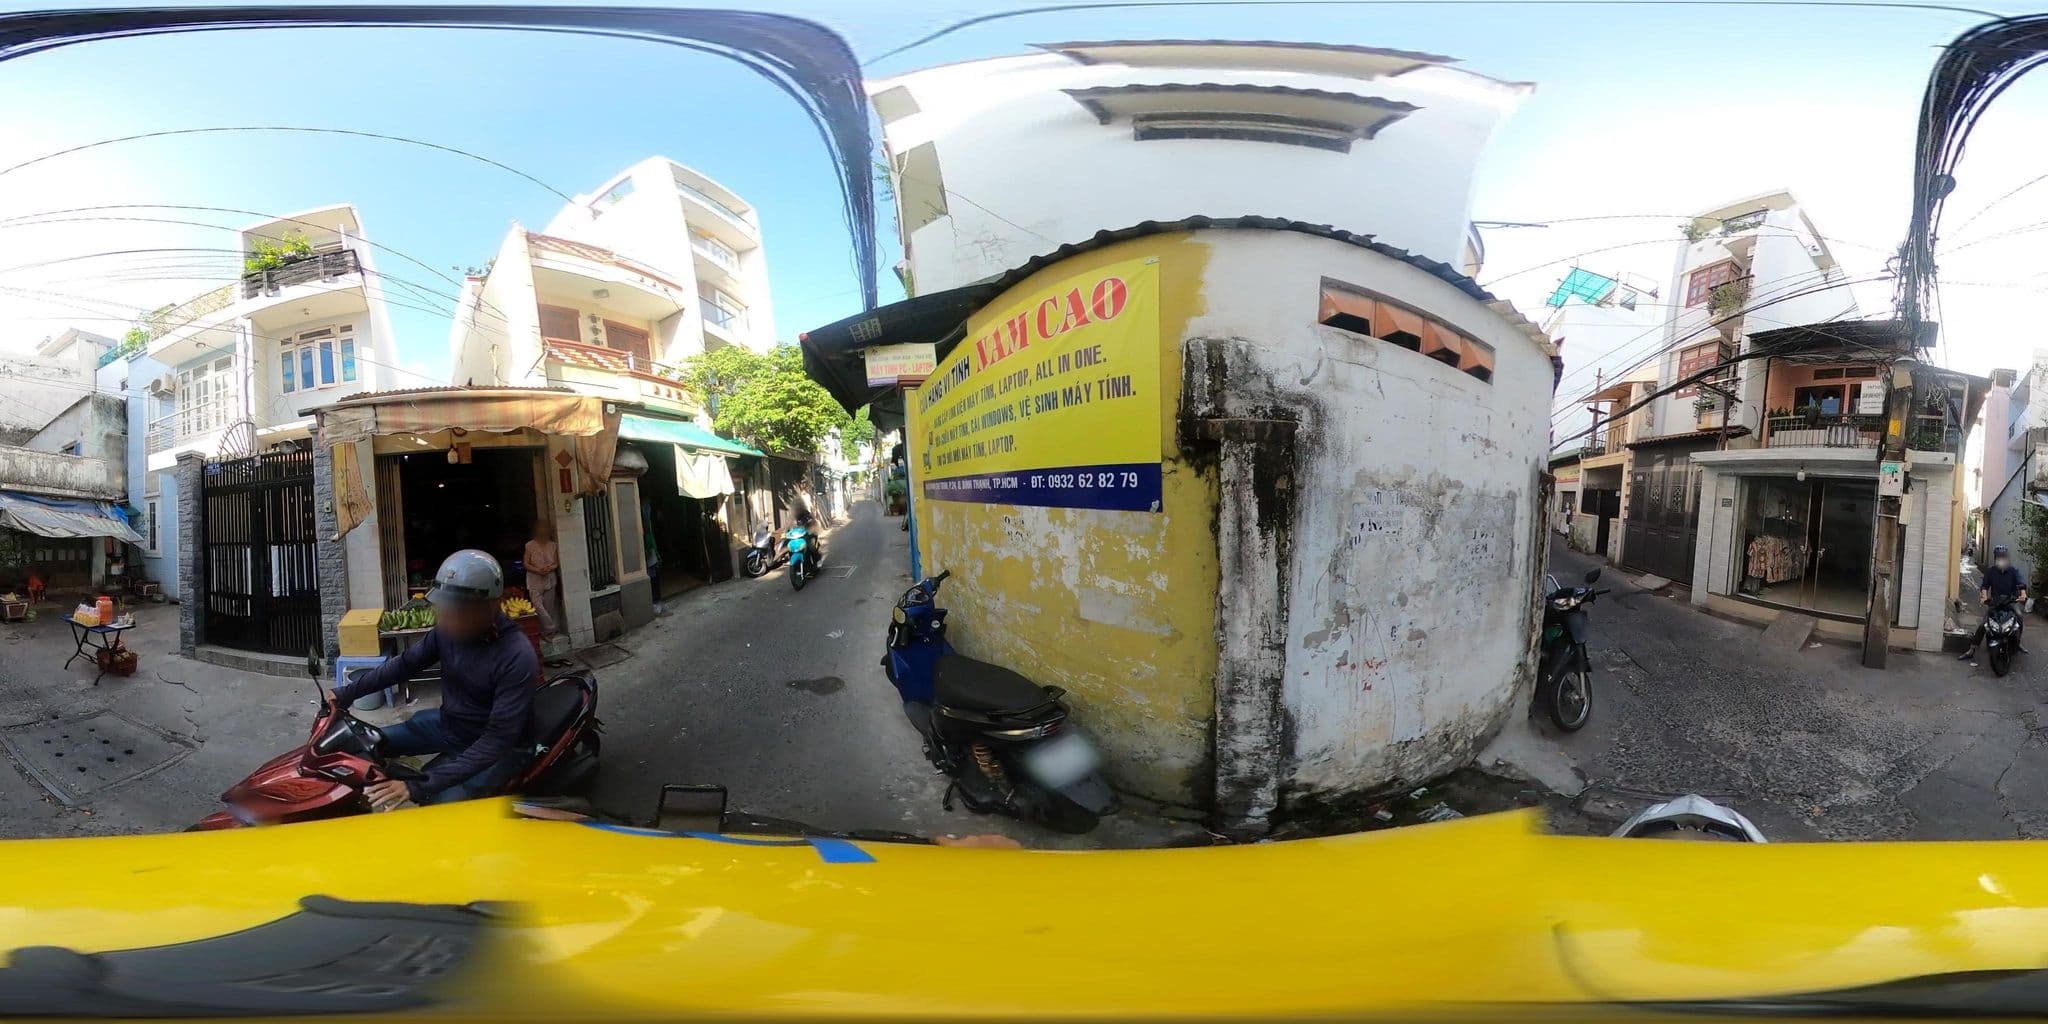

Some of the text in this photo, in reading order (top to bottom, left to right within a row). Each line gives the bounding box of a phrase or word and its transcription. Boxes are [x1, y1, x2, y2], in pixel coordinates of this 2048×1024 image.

[976, 277, 1128, 373] NAM CAO
[943, 372, 950, 394] VI
[952, 355, 970, 388] TÍNH
[967, 391, 979, 410] MÁY
[980, 383, 996, 403] TÍNH,
[999, 368, 1032, 395] LAPTOP,
[1036, 359, 1054, 381] ALL
[1058, 353, 1070, 374] IN
[1074, 345, 1107, 369] ONE.
[971, 414, 980, 433] CÀI
[981, 404, 1016, 430] WINDOWS,
[1019, 395, 1031, 420] VỆ
[1035, 390, 1058, 414] SINH
[1062, 381, 1092, 408] MÁY
[1097, 374, 1136, 400] TÍNH.
[988, 434, 1017, 455] LAPTOP.
[992, 477, 1018, 489] TP.HCM
[1031, 475, 1046, 488] ĐT:
[1048, 474, 1074, 489] 0932
[1078, 473, 1094, 488] 62
[1098, 472, 1114, 488] 82
[1120, 472, 1138, 488] 79
